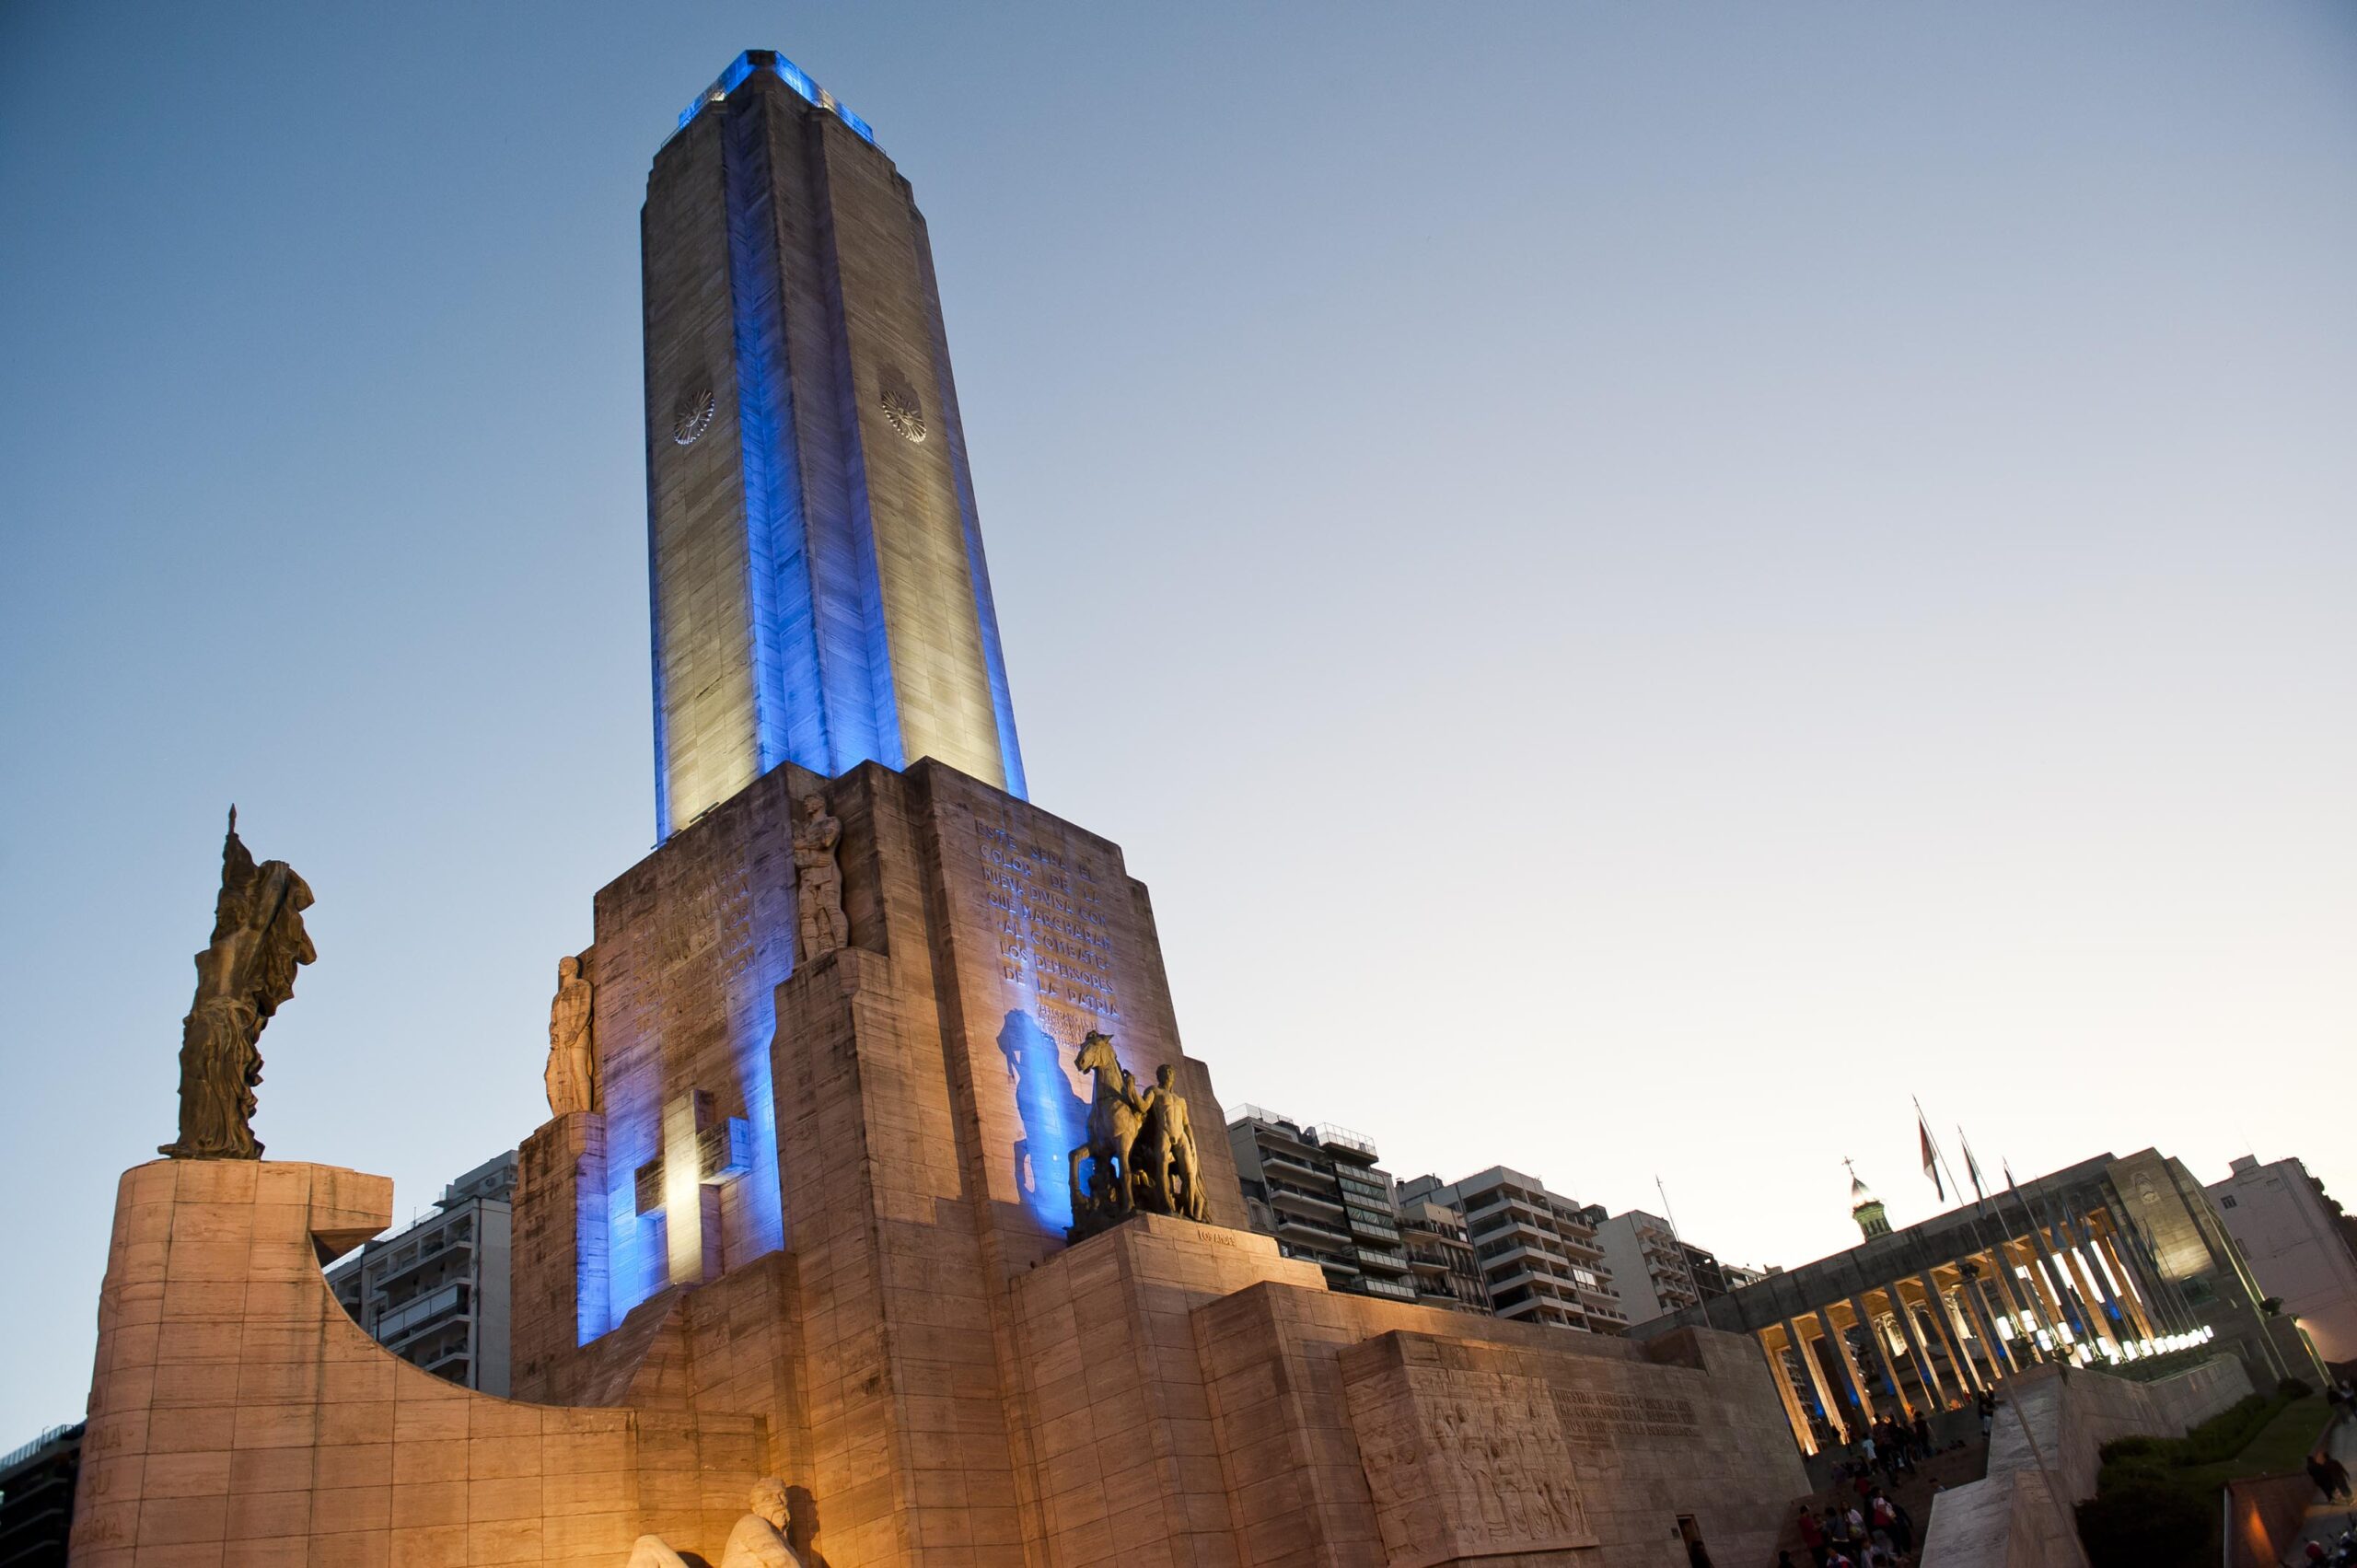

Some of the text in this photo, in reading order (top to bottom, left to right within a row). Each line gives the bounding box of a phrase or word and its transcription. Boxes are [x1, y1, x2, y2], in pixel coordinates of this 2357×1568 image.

[976, 820, 1016, 850] ESTE
[1078, 865, 1097, 884] EL
[979, 843, 1101, 904] COLOR DE LA
[981, 866, 1106, 927] NUEVA DIVISA CON
[987, 890, 1017, 915] QUE
[1000, 940, 1113, 994] LOS DEFENSORES
[1004, 965, 1120, 1018] DE LA PATRIA
